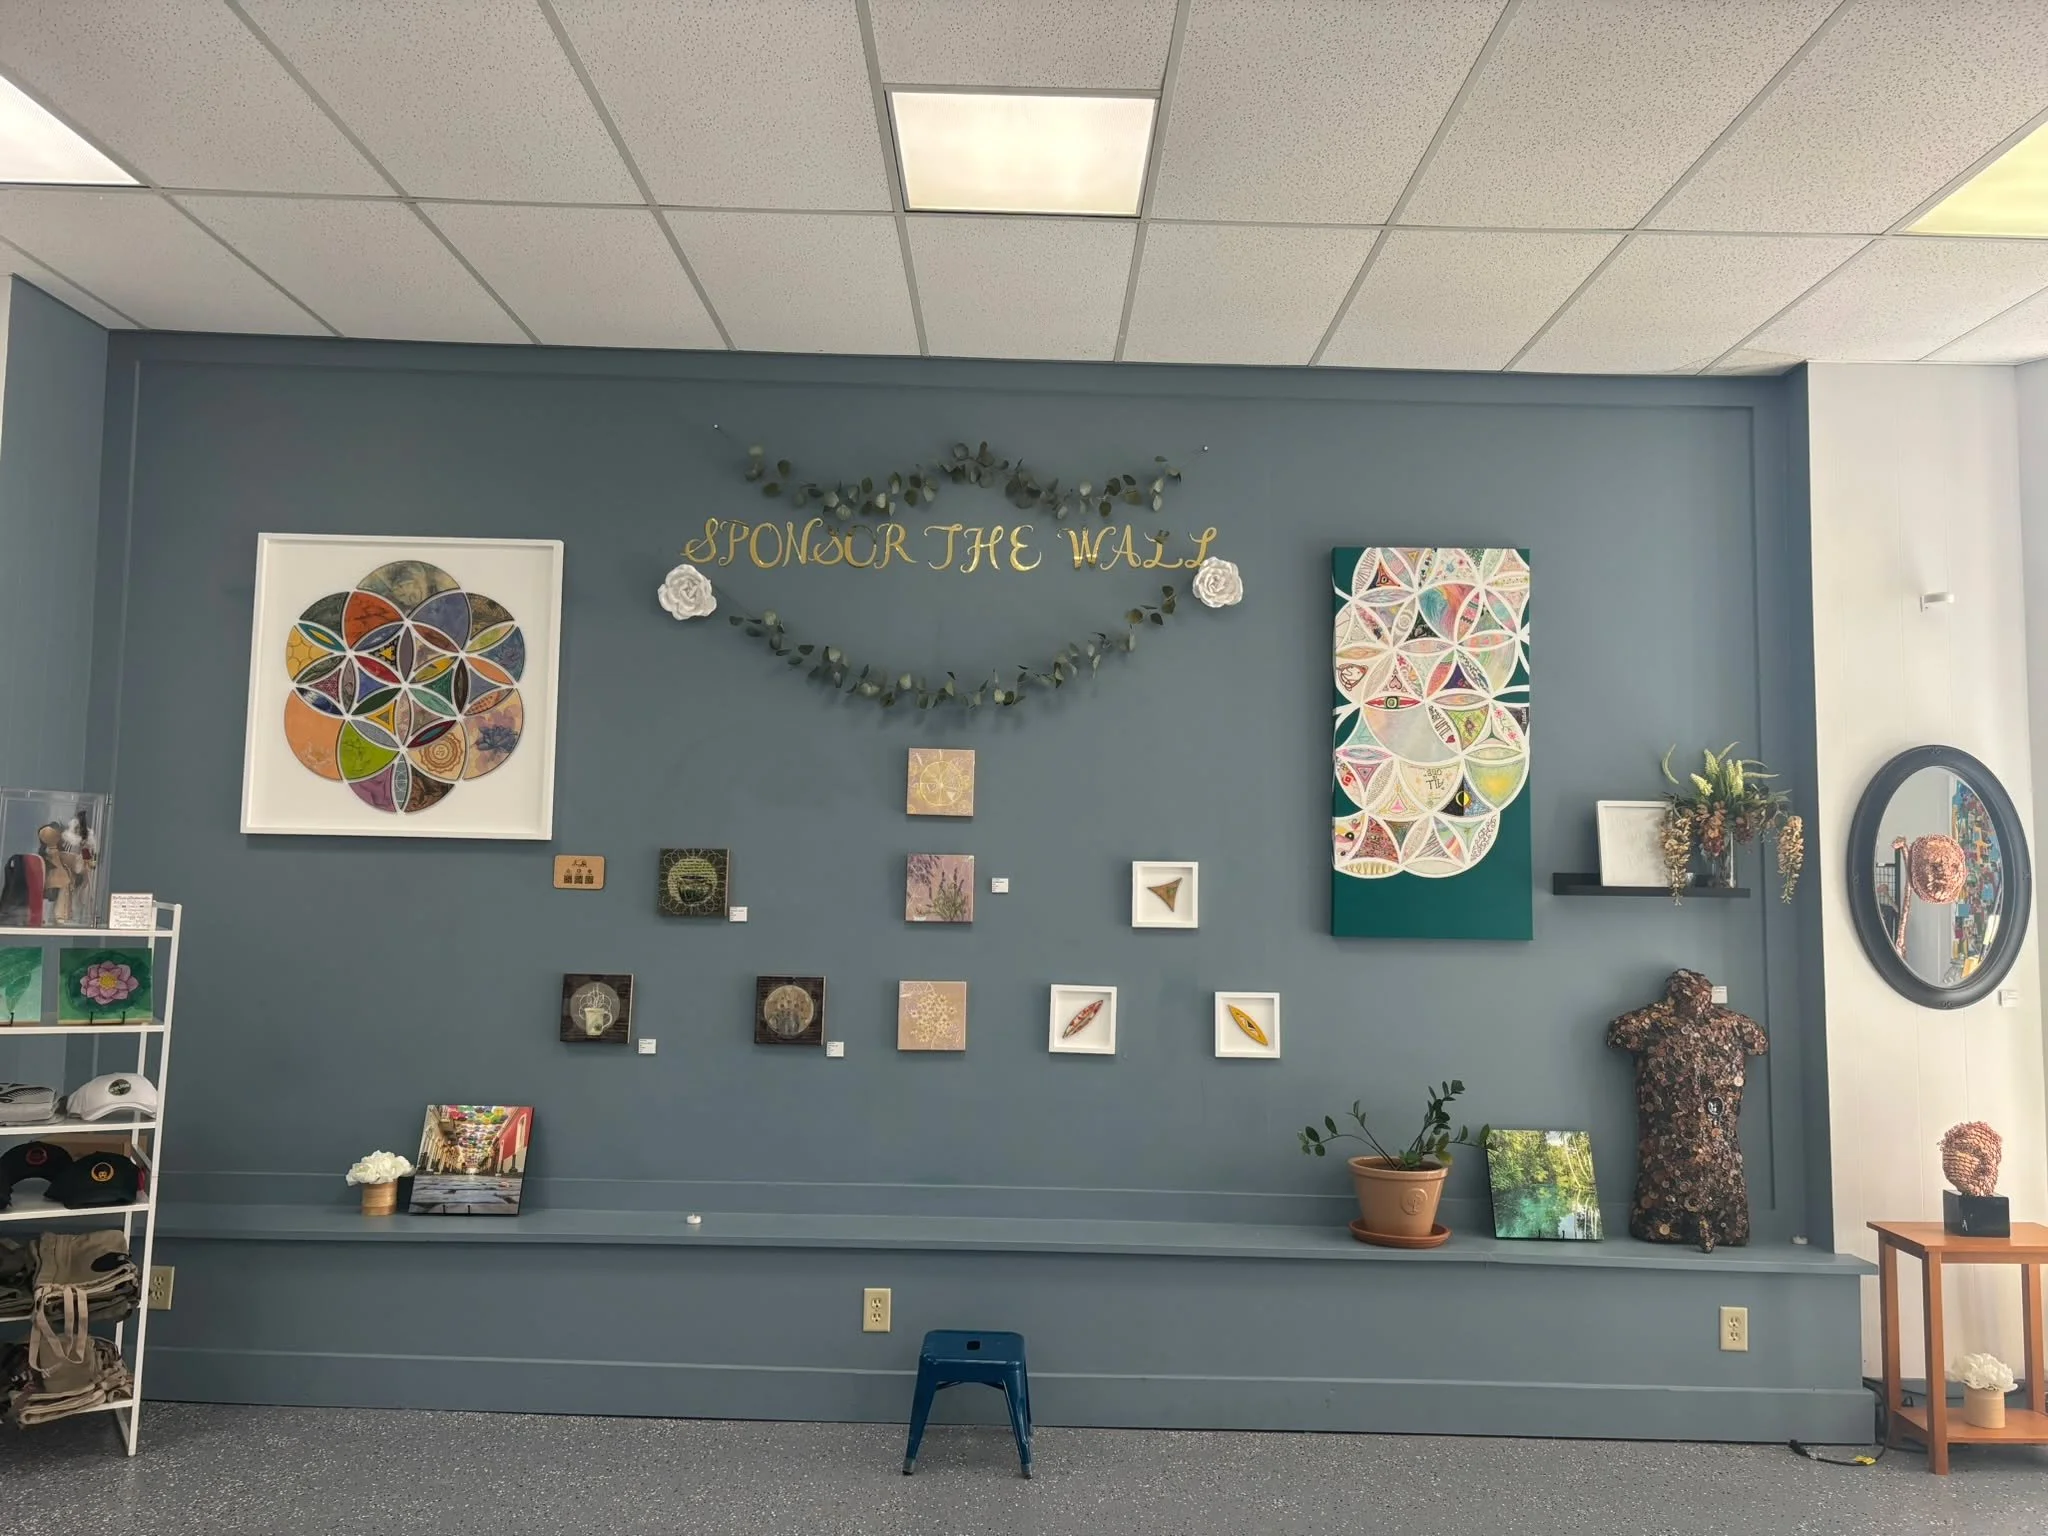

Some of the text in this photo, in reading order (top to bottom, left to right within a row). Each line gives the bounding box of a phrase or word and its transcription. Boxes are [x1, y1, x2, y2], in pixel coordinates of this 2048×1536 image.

[680, 517, 1217, 572] SPONSOR THE WALL
